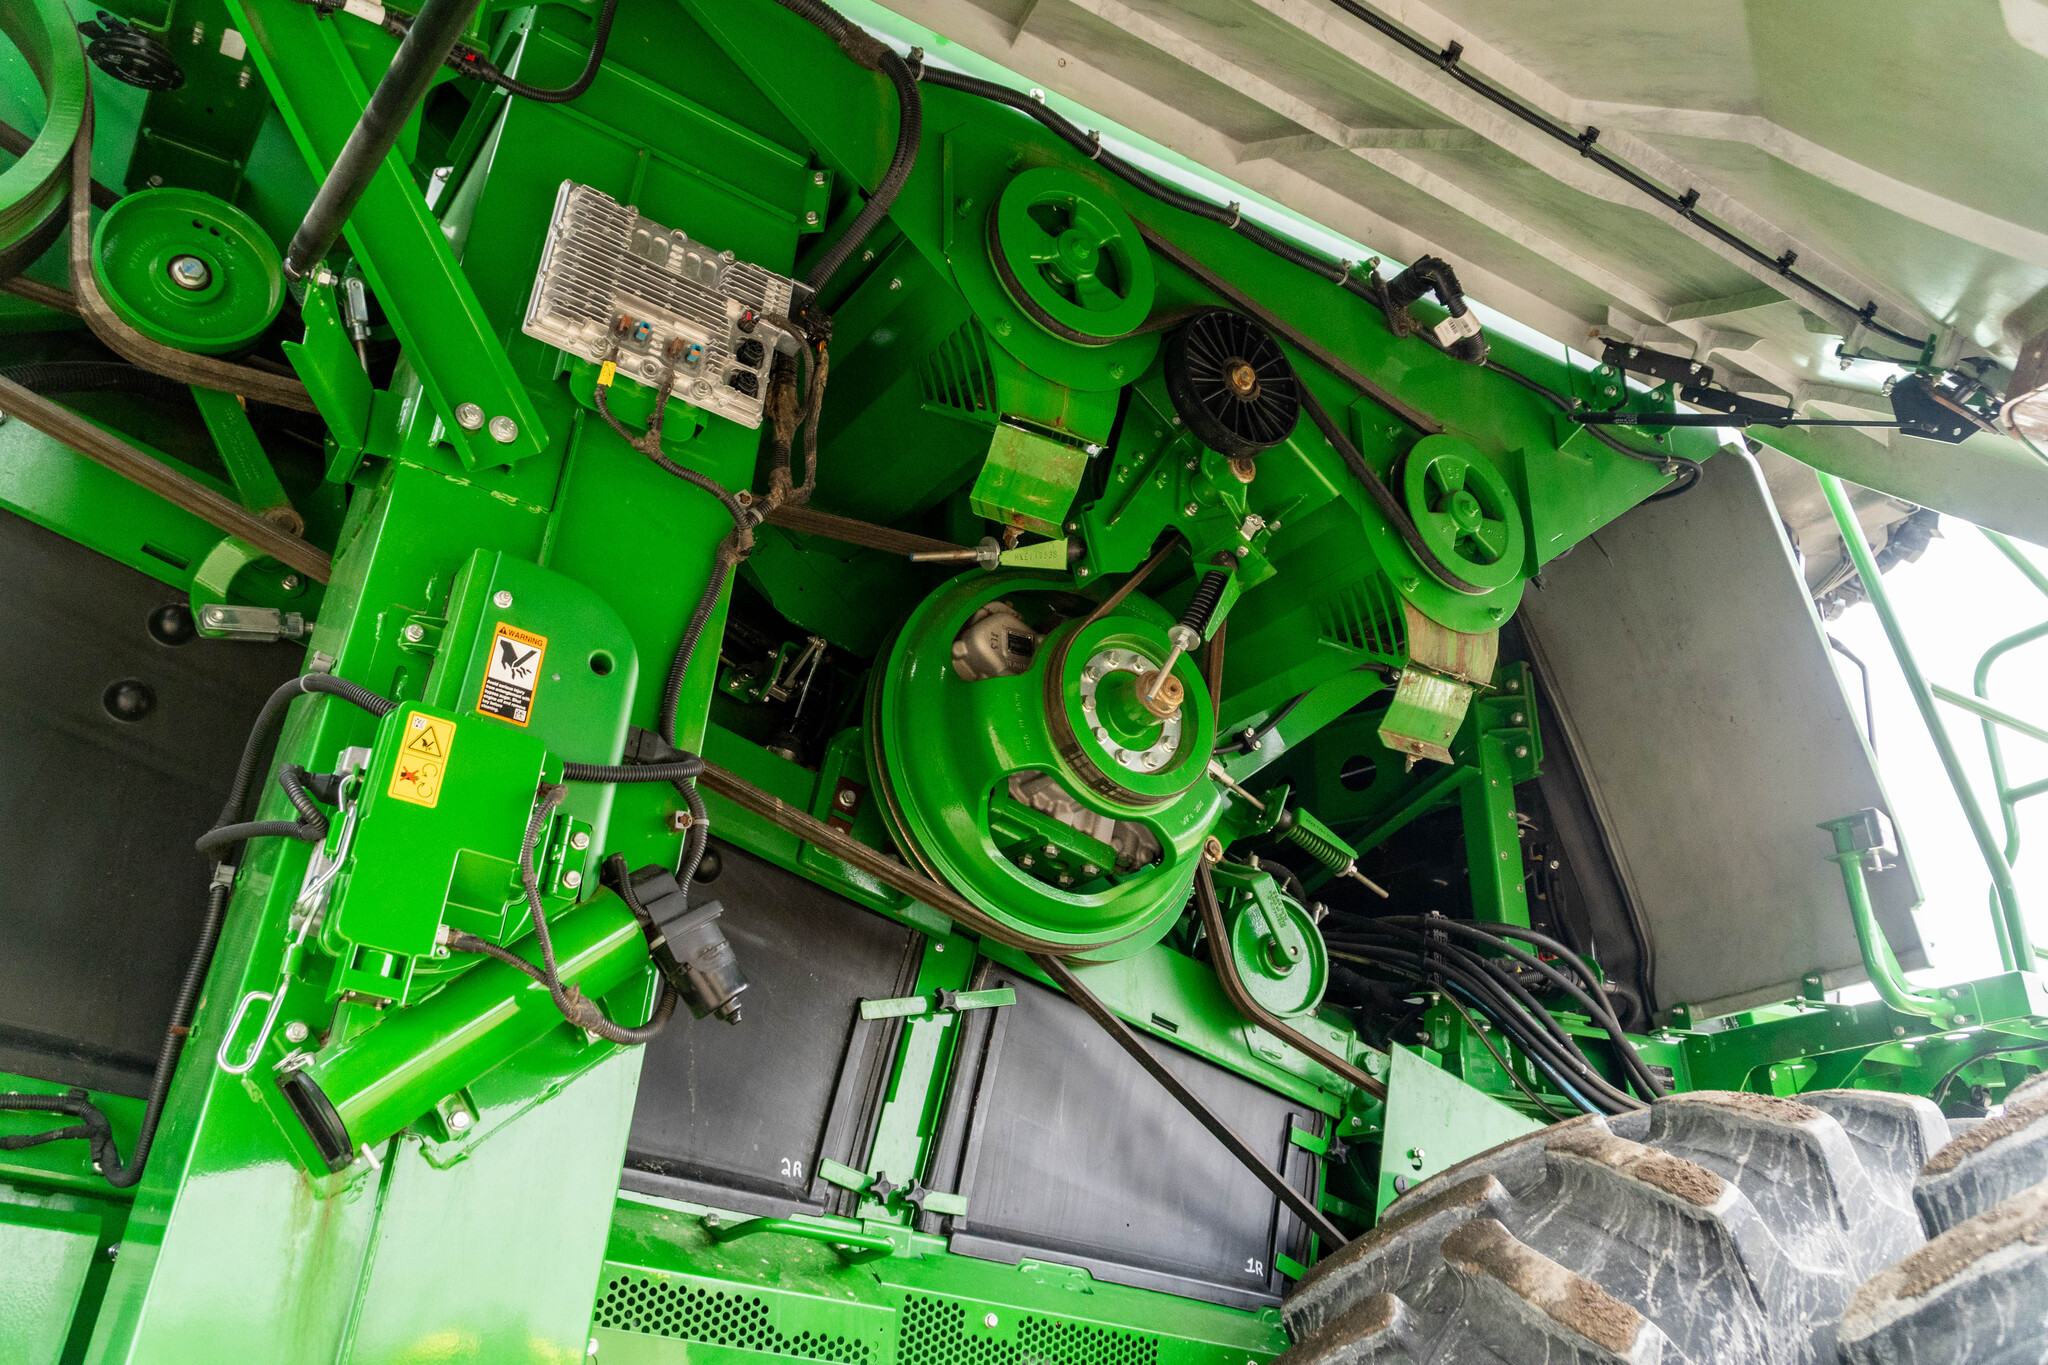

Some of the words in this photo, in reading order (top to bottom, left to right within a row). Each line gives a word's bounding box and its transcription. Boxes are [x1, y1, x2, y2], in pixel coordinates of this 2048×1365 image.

[508, 629, 543, 647] WARNING
[781, 1157, 802, 1178] 2R
[1244, 1257, 1264, 1277] 1R
